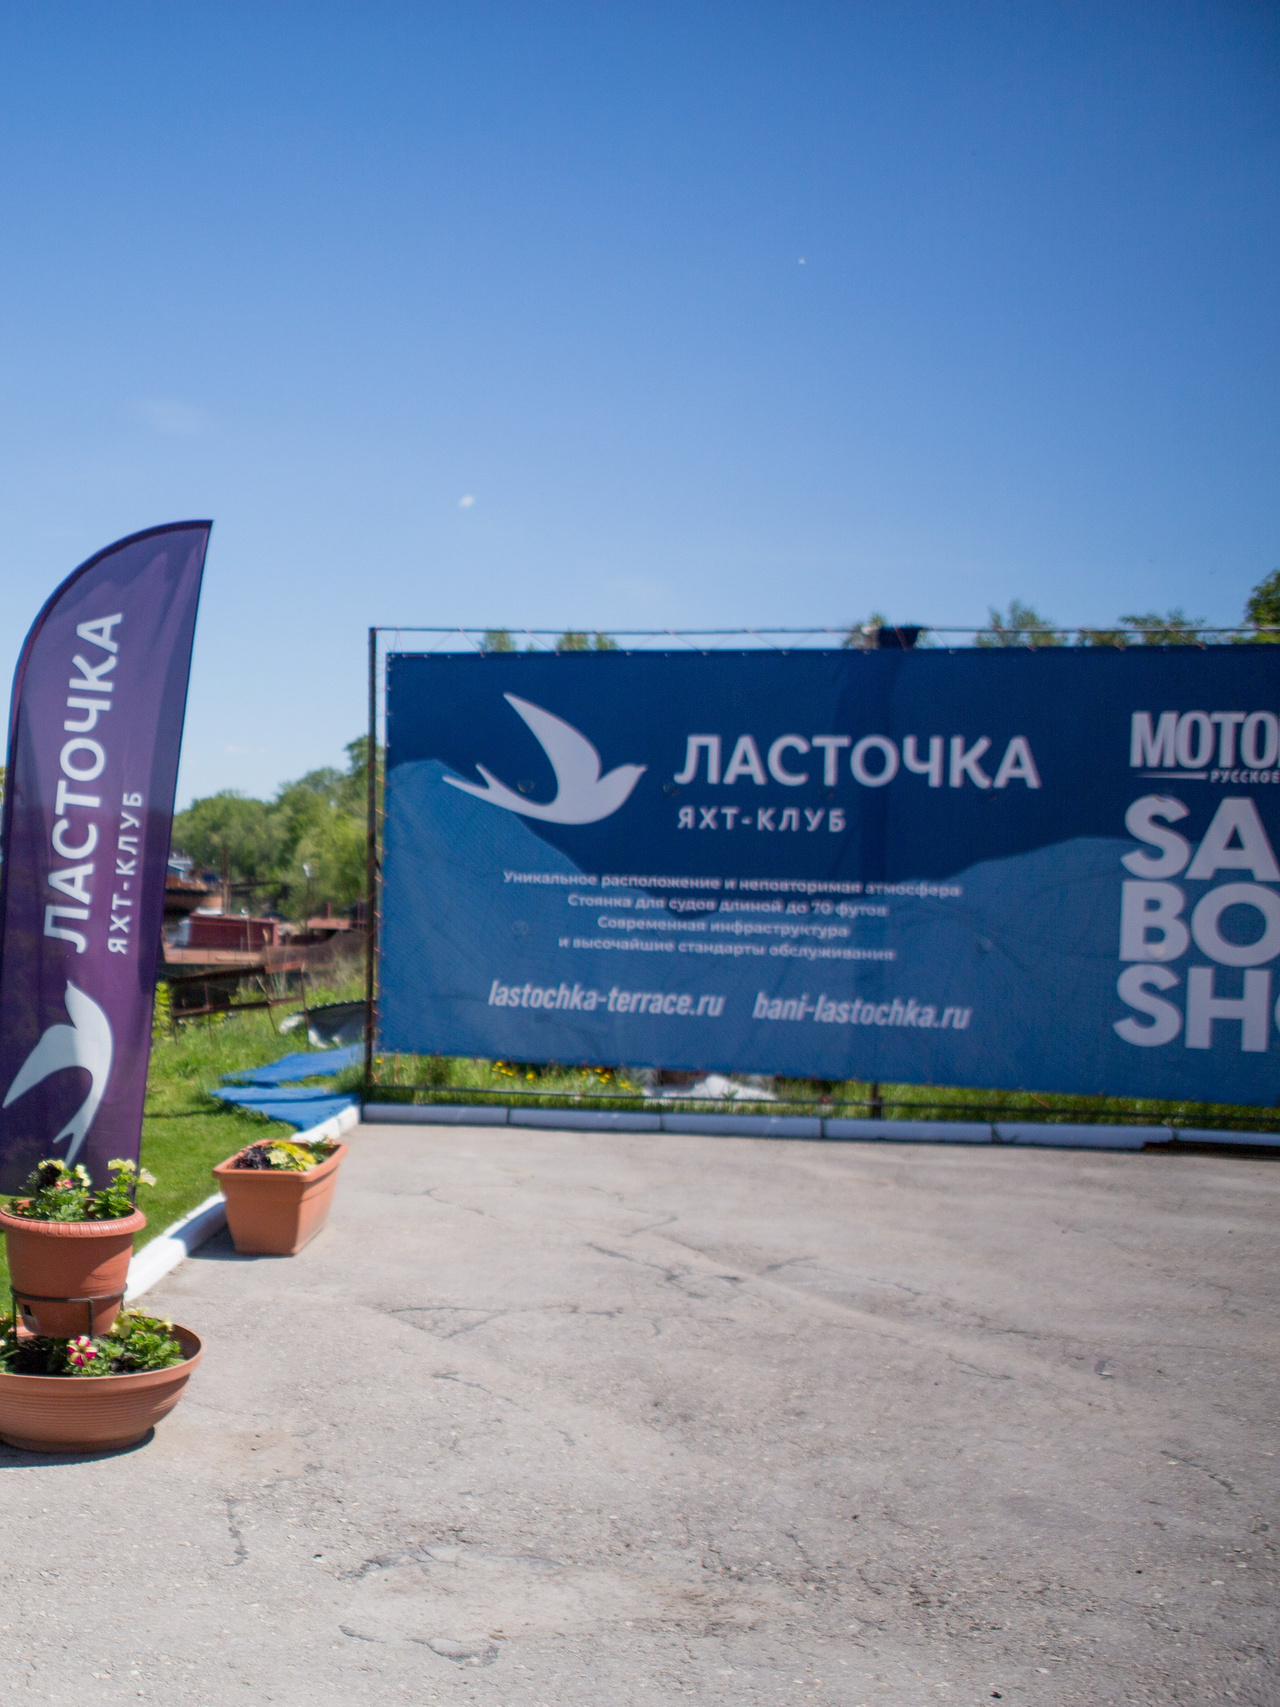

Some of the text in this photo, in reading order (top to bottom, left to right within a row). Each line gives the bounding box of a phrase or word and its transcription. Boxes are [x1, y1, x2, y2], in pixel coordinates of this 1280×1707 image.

[673, 733, 1042, 790] ЛАСТОЧКА
[1129, 710, 1280, 769] МОТО
[43, 613, 123, 954] ЛАСТОЧКА
[677, 807, 847, 833] ЯХТ-КЛУБ
[107, 792, 143, 955] ЯХТ-КЛУБ
[503, 870, 962, 899] Уникальное расположение и неповторимая атмосфера
[568, 893, 890, 919] Стоянка для судов длиной до 70 футов
[597, 915, 851, 940] Современная инфраструктура
[558, 937, 897, 962] и высочайшие стандарты обслуживания
[487, 979, 973, 1030] lastochka-terrace.ru bani-lastochka.ru
[1112, 964, 1280, 1053] SH
